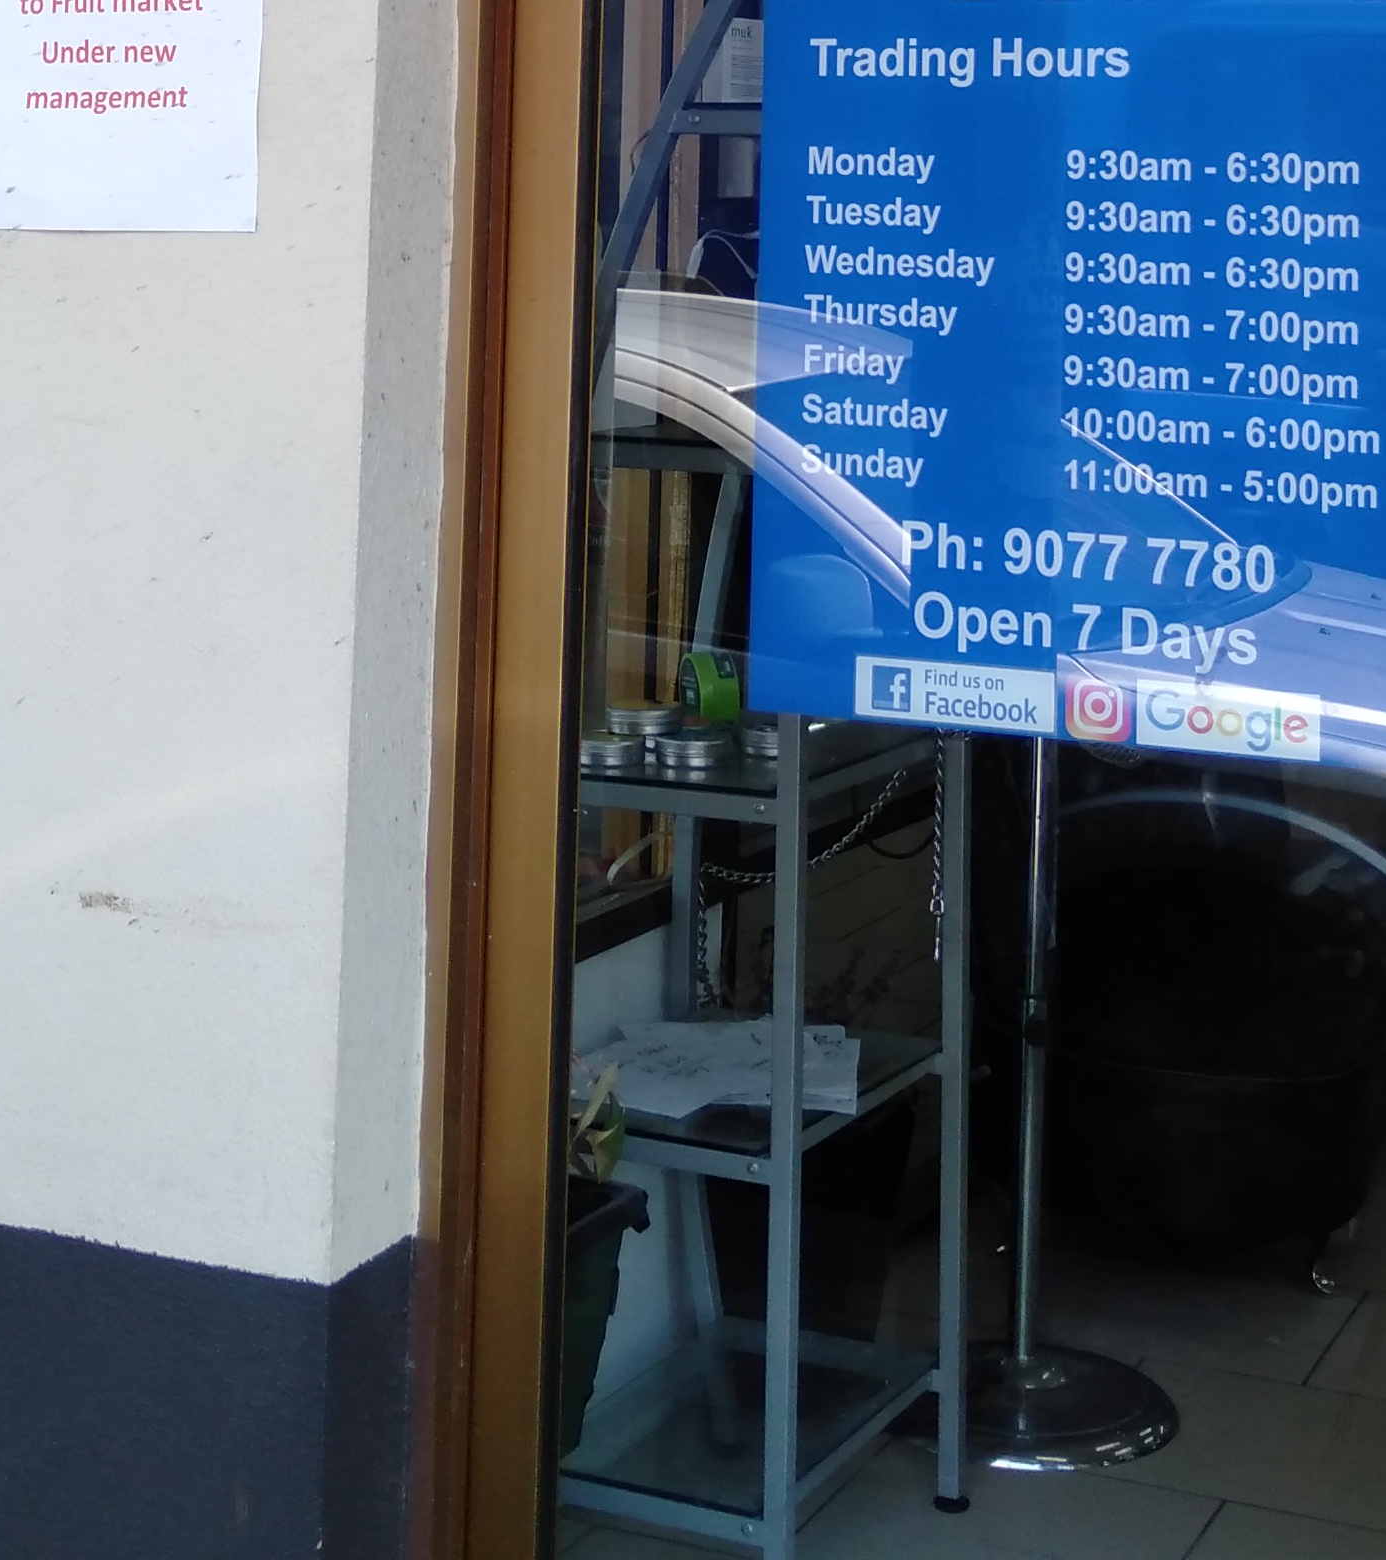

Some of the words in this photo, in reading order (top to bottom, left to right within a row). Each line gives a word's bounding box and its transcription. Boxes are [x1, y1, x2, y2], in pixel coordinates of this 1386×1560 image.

[41, 39, 116, 65] Under
[123, 42, 177, 64] new
[810, 37, 976, 88] Trading
[991, 37, 1131, 79] Hours
[25, 85, 189, 115] management
[807, 145, 935, 185] Monday
[1066, 148, 1192, 183] 9:30am
[1225, 150, 1360, 192] 6:30pm
[805, 195, 941, 235] Tuesday
[1065, 199, 1192, 234] 9:30am
[1225, 203, 1360, 244] 6:30pm
[804, 244, 995, 287] Wednesday
[1064, 250, 1191, 287] 9:30am
[1224, 255, 1360, 298] 6:30pm
[803, 293, 957, 336] Thursday
[1064, 302, 1191, 339] 9:30am
[1224, 309, 1360, 350] 7:00pm
[803, 344, 904, 385] Friday
[1063, 354, 1190, 391] 9:30am
[1224, 361, 1359, 404] 7:00pm
[801, 392, 948, 438] Saturday
[1064, 406, 1210, 444] 10:00am
[1244, 416, 1381, 461] 6:00pm
[800, 444, 924, 488] Sunday
[1063, 459, 1208, 498] 11:00am
[1242, 469, 1379, 514] 5:00pm
[900, 520, 985, 572] Ph:
[1003, 527, 1128, 582] 9077
[1146, 537, 1276, 594] 7780
[913, 591, 1052, 653] Open
[1071, 602, 1102, 651] 7
[1121, 607, 1259, 674] Days
[924, 669, 959, 687] Find
[961, 676, 981, 690] us
[984, 677, 1005, 691] on
[924, 691, 1038, 725] Facebook
[1144, 687, 1310, 753] Google
